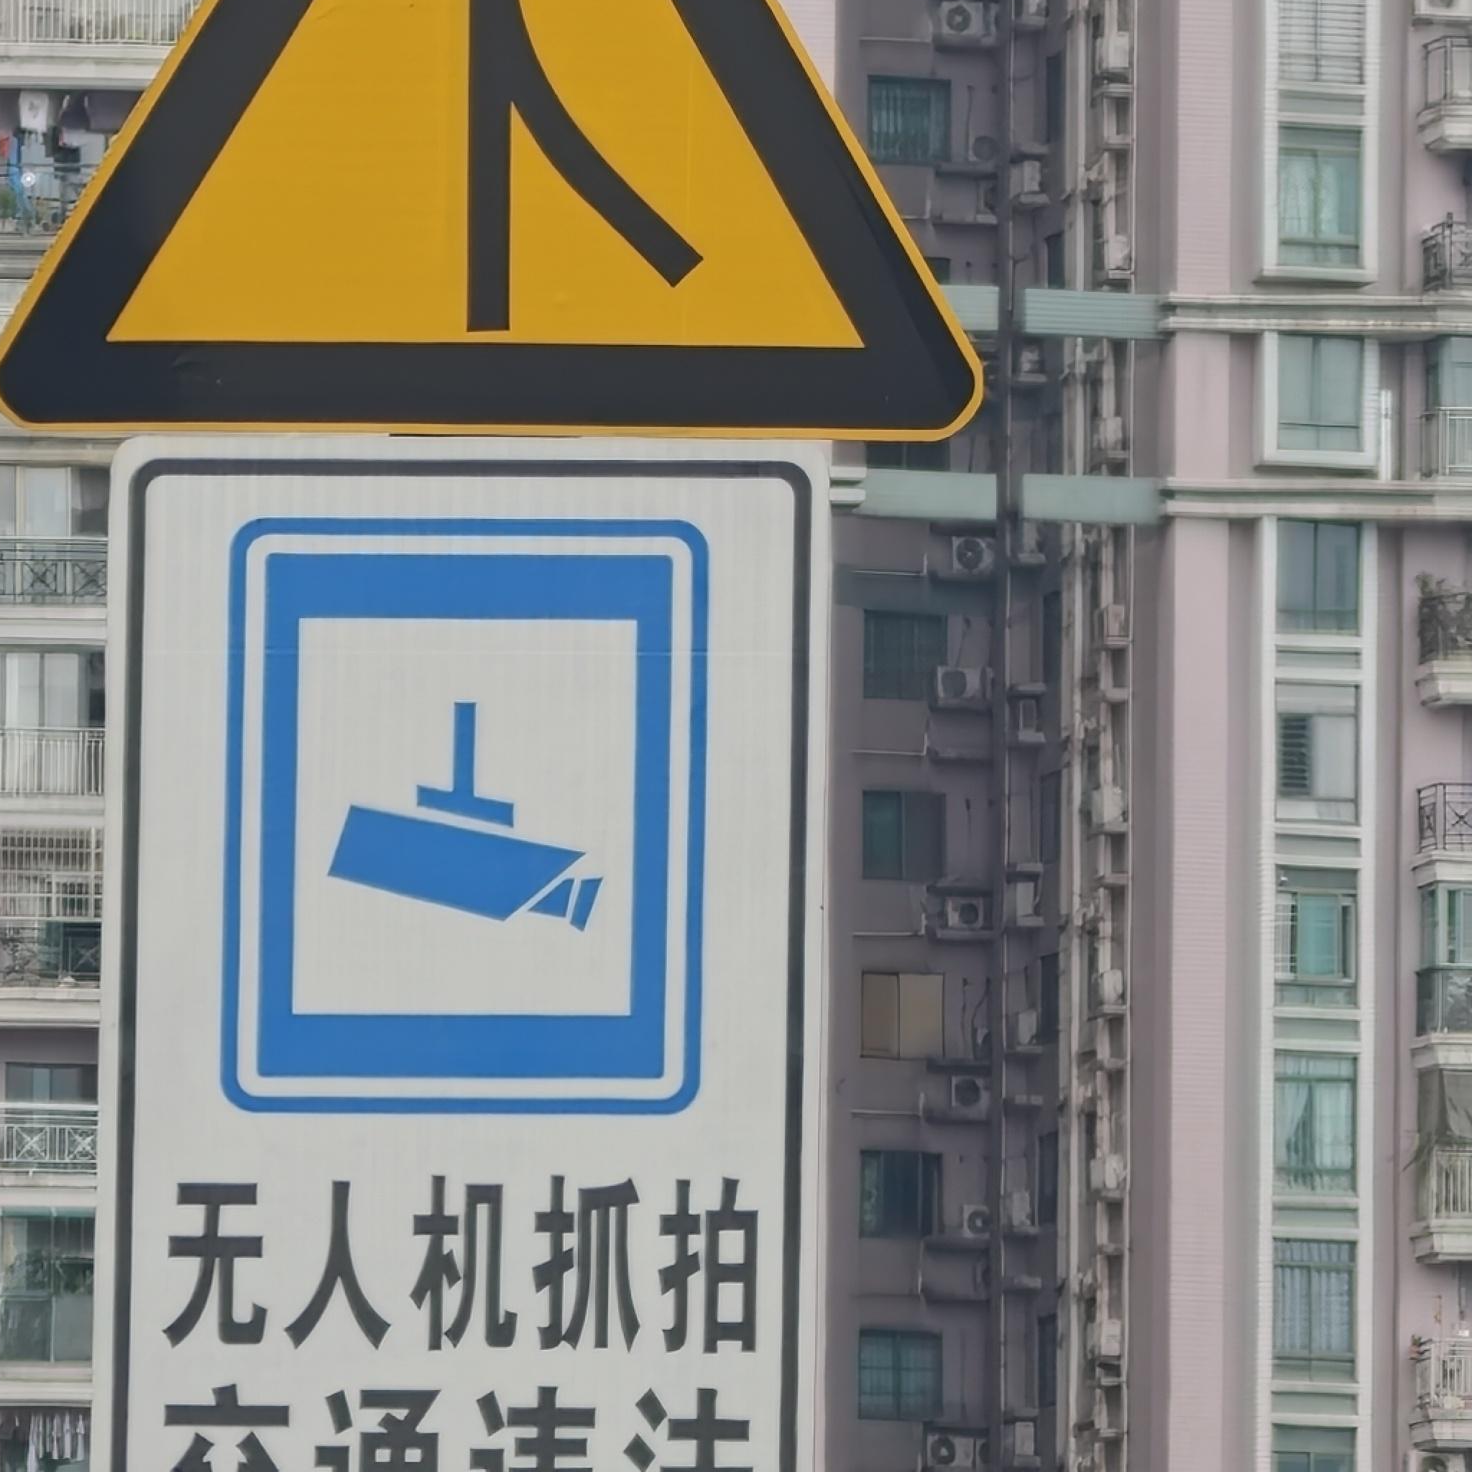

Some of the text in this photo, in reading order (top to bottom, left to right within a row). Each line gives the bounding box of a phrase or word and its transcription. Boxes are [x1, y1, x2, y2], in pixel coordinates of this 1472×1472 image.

[163, 1175, 759, 1353] 无人机抓拍
